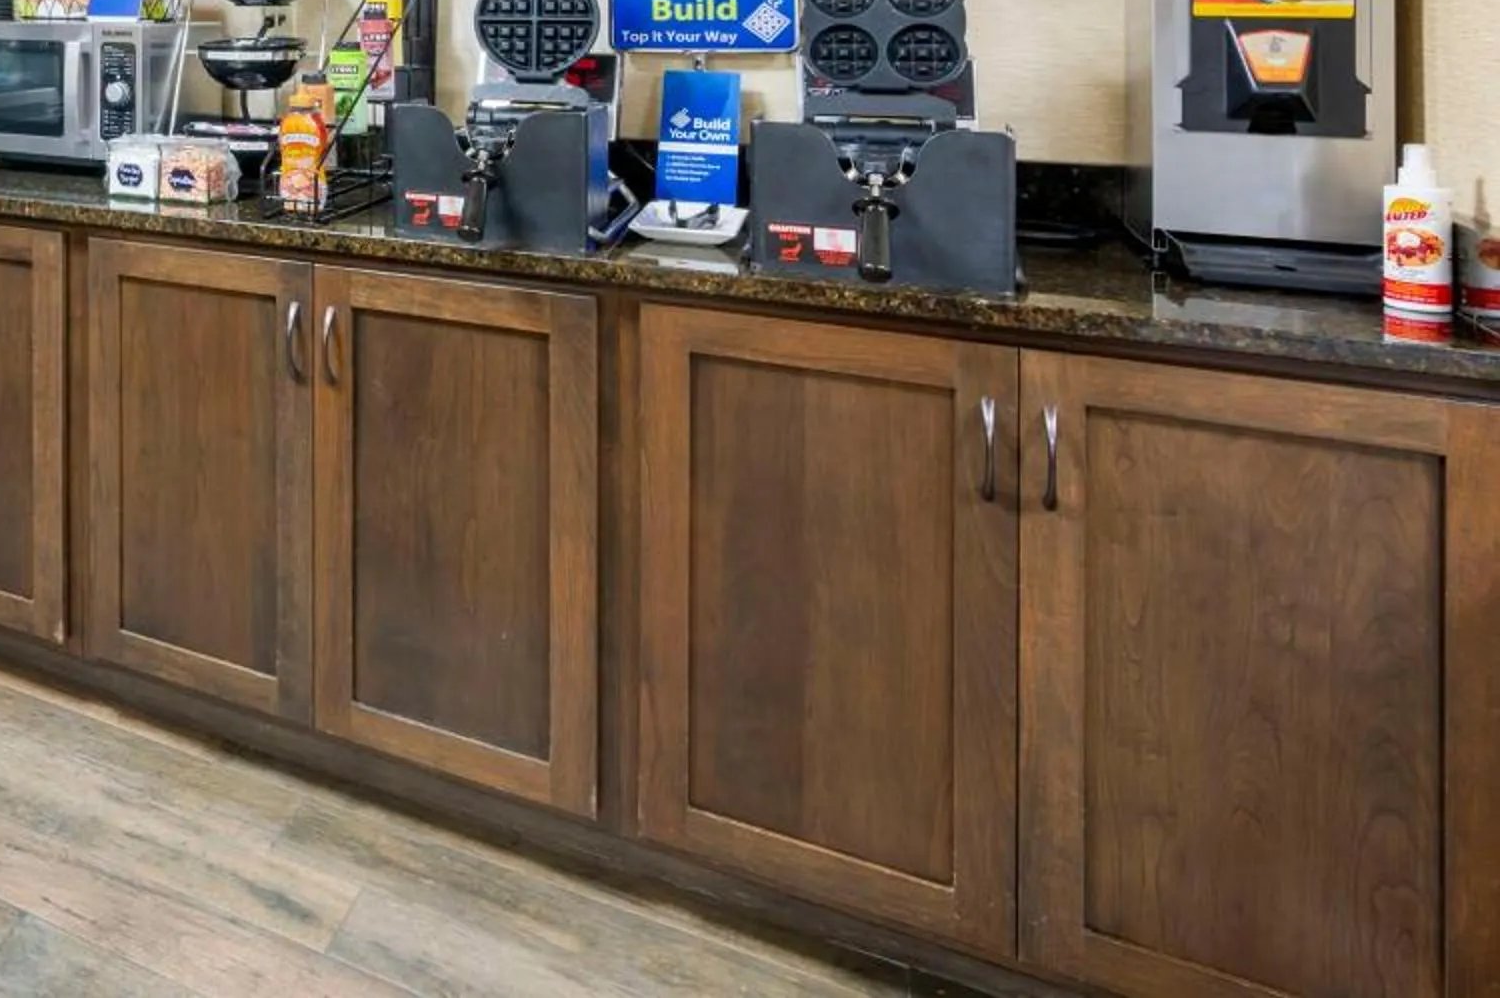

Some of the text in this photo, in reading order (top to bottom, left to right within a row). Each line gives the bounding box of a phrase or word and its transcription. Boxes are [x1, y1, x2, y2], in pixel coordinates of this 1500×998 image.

[622, 30, 738, 45] Top It Your Way
[693, 117, 731, 131] Build
[669, 128, 730, 141] Your Own
